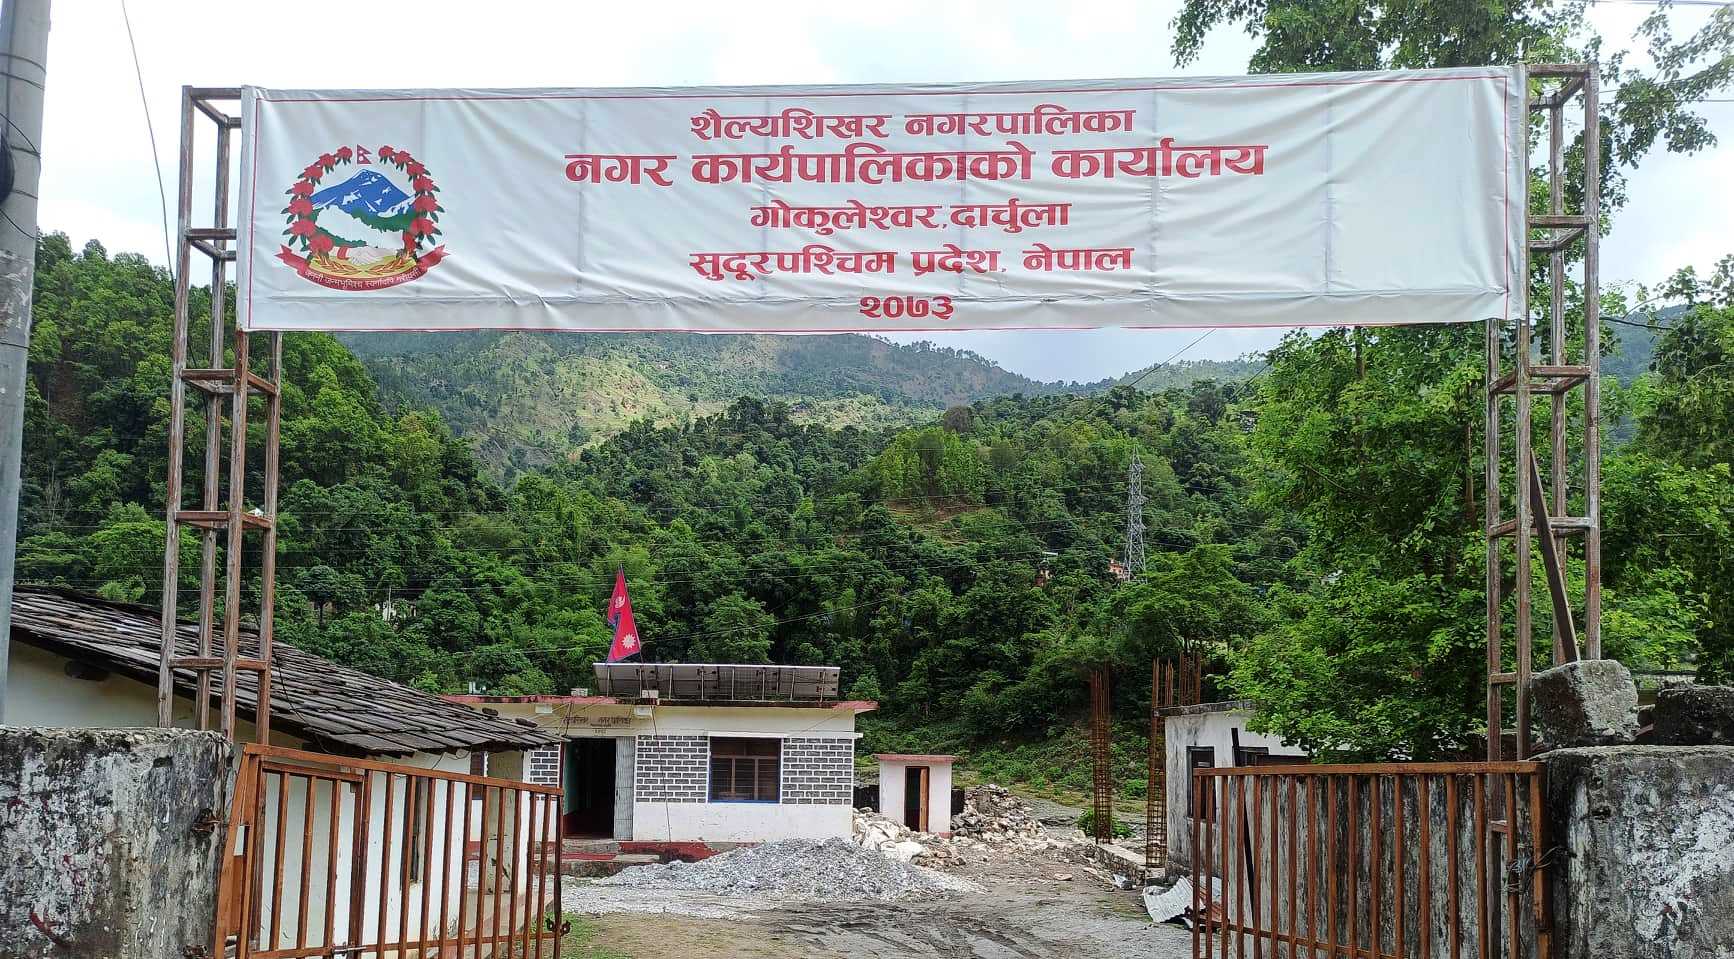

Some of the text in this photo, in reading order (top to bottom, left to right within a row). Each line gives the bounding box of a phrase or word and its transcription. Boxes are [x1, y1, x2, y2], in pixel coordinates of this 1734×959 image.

[690, 105, 1136, 142] शैल्यशिखर नगरपालिका
[566, 137, 1267, 187] नगर कार्यपालिकाको कार्यालय
[689, 245, 898, 281] सुदूरपश्चिम
[1022, 242, 1134, 272] नेपाल
[859, 295, 955, 321] २०७३
